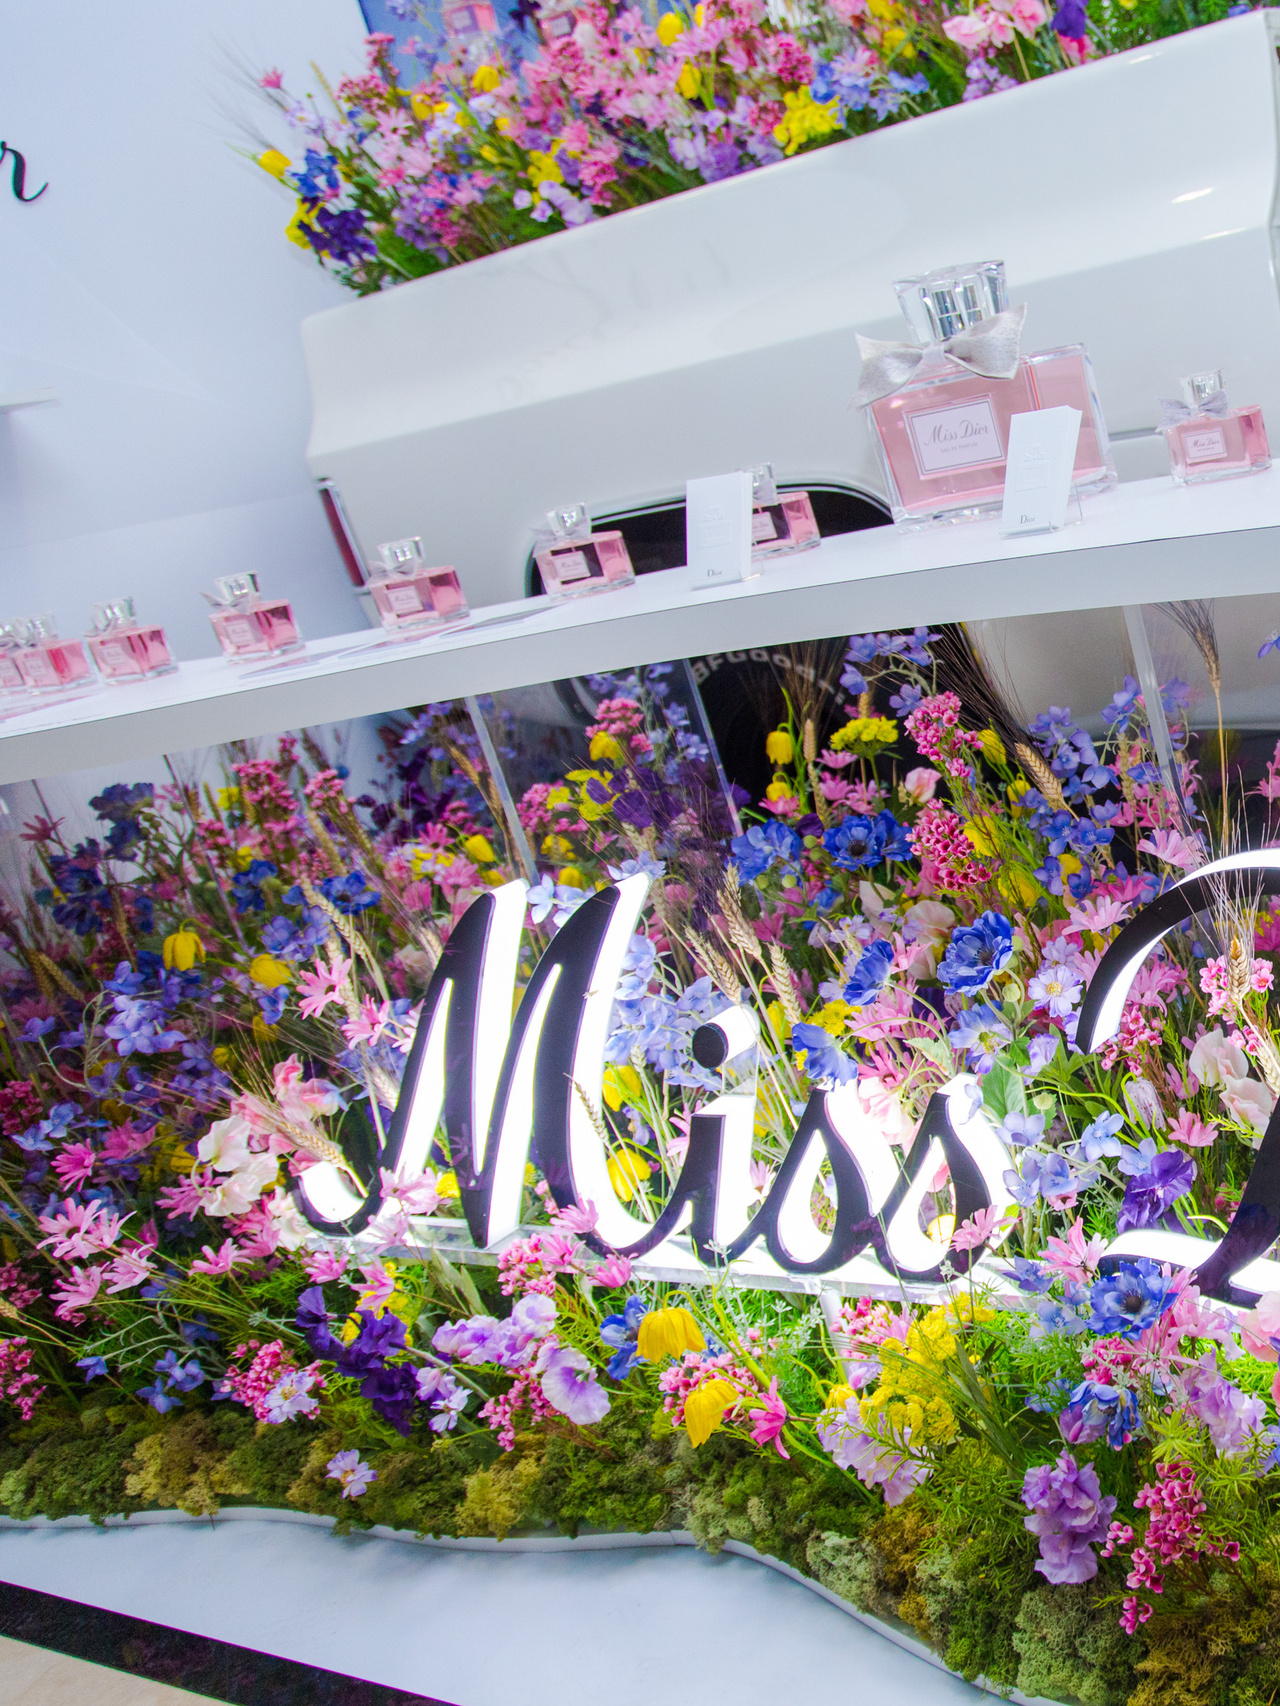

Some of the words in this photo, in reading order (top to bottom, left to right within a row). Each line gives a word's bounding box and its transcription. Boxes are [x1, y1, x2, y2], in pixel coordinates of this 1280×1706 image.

[923, 424, 958, 446] Miss
[958, 419, 989, 438] Dior
[1020, 514, 1036, 524] Dior
[299, 878, 1005, 1282] Miss
